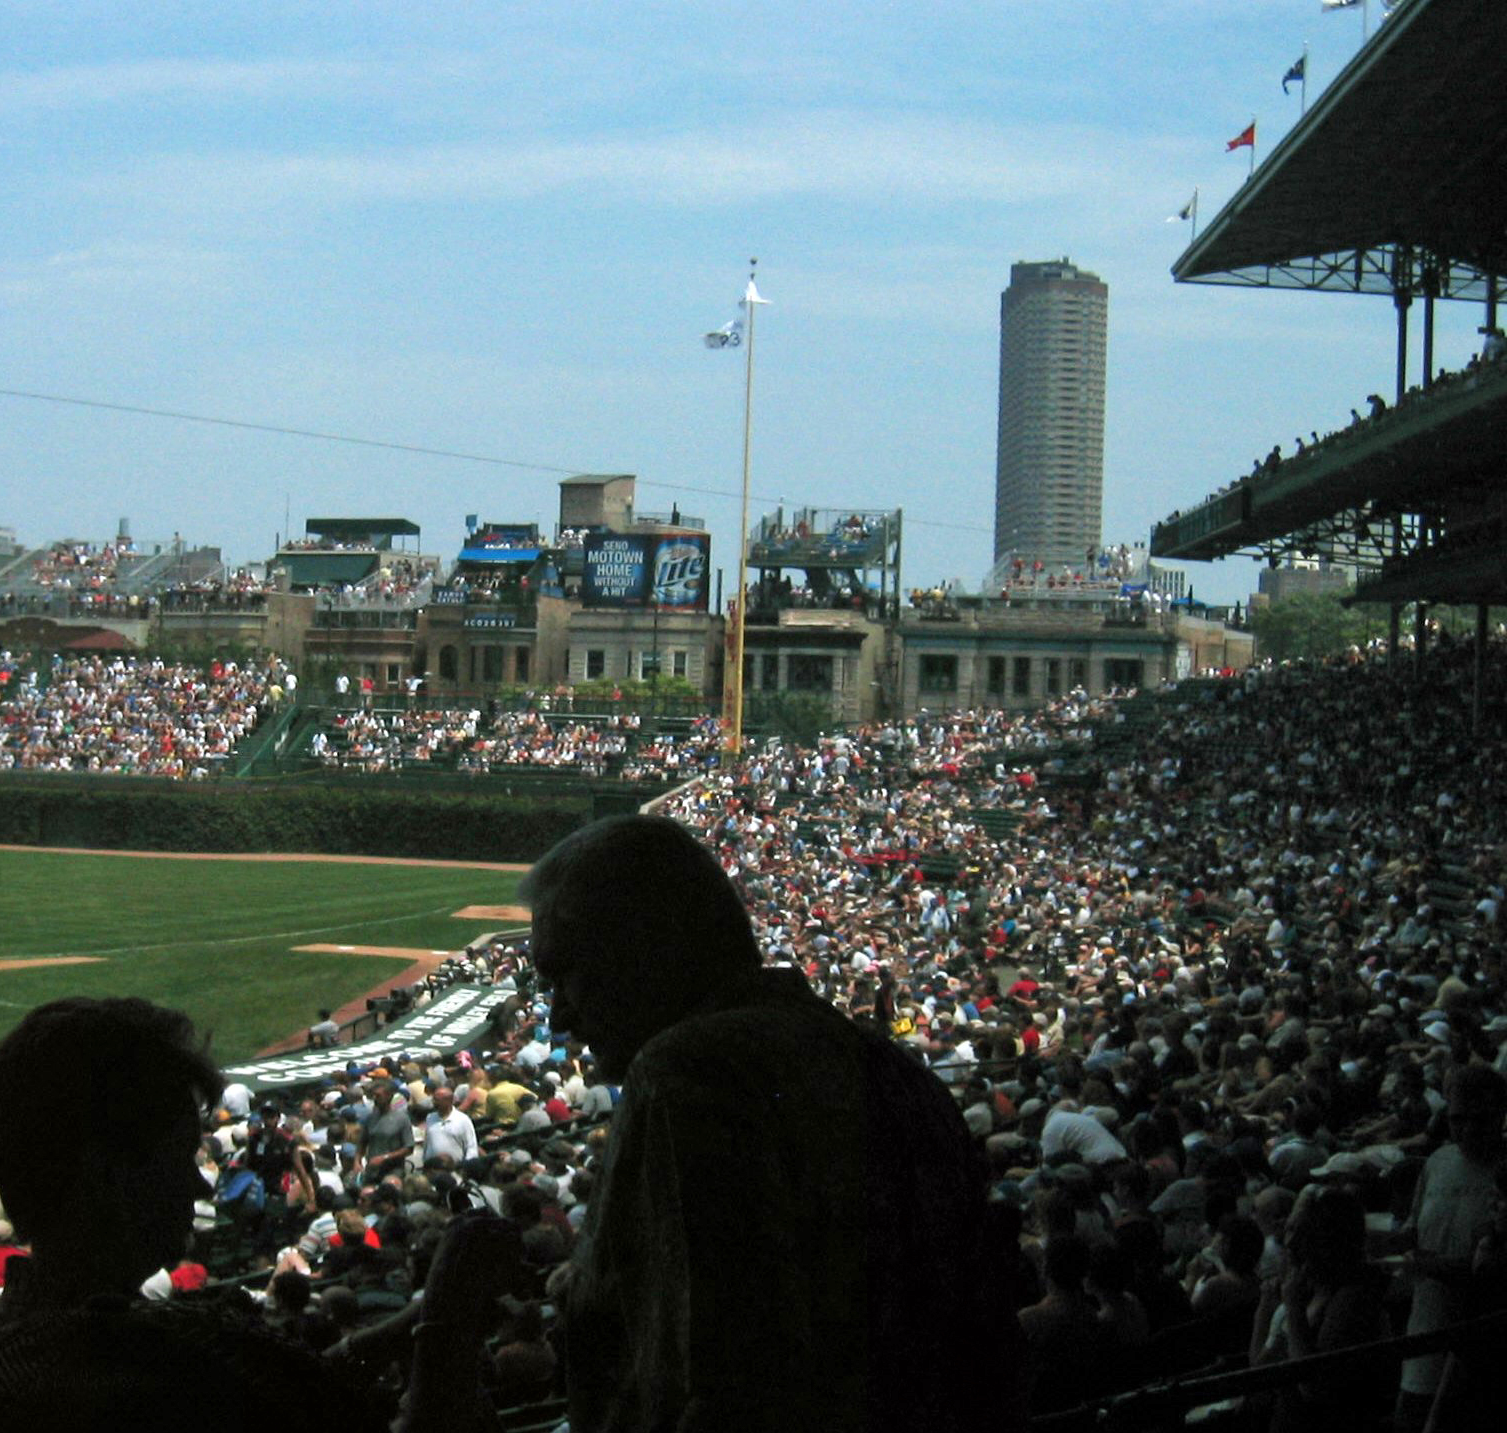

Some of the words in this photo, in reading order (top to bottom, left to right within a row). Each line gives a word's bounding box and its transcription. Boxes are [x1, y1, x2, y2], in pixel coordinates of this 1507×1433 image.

[603, 541, 628, 550] SEND
[588, 550, 643, 564] MOTOWN
[597, 564, 632, 577] HOME
[594, 577, 635, 586] WITHOUT
[602, 587, 608, 596] A
[610, 587, 627, 597] HIT
[404, 1016, 443, 1029] THE
[387, 1029, 423, 1039] TO
[425, 1034, 457, 1046] OF
[224, 1040, 403, 1076] WELCOME
